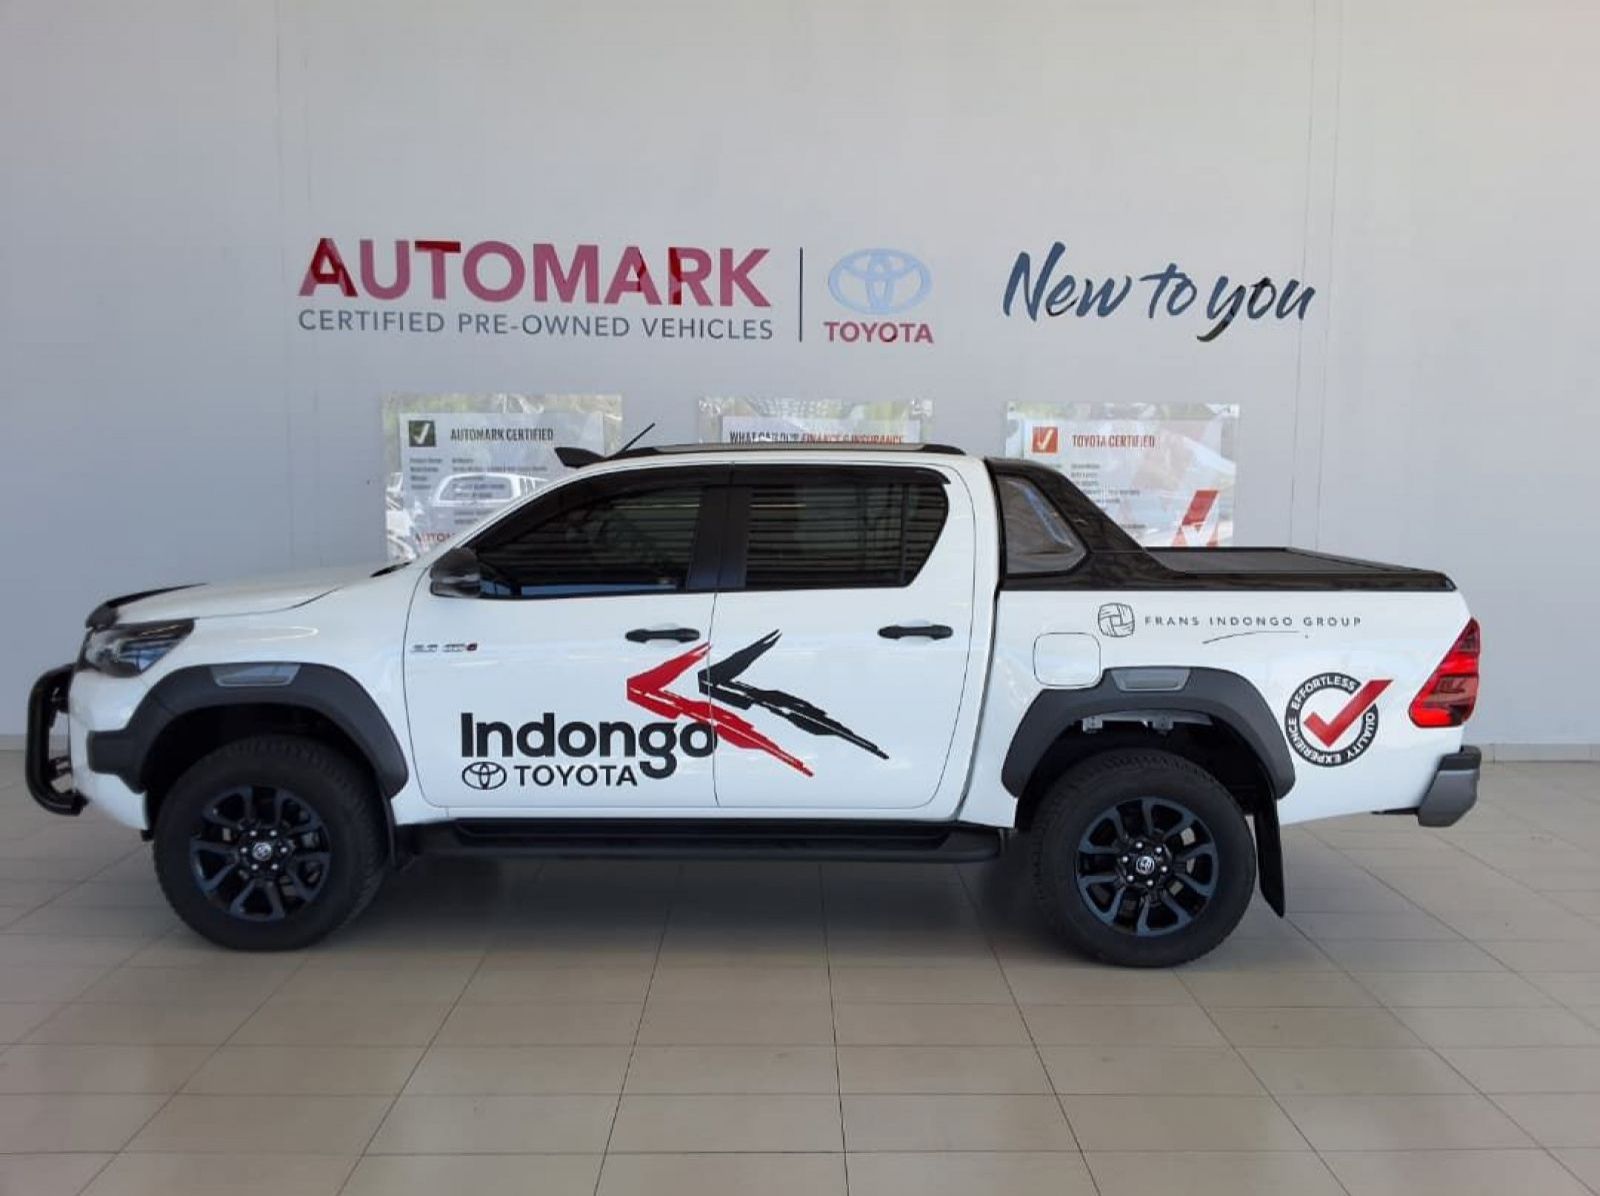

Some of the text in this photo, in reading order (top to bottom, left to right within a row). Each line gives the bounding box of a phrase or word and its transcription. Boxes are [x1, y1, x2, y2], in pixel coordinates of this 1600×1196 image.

[298, 237, 772, 307] AUTOMARK
[1003, 241, 1316, 343] New to you
[299, 309, 774, 341] CERTIFIED PRE-OWNED VEHICLES
[823, 321, 934, 345] TOYOTA
[450, 427, 554, 442] AUTOMARK CERTIFIED
[728, 430, 756, 443] WHAT
[1072, 435, 1156, 448] TOYOTA CERTIFIED
[1144, 616, 1362, 627] FRANS INDONGO GROUP
[1288, 675, 1376, 765] EFFORTLESS QUALITY EXPERIENCE
[460, 712, 718, 779] Indongo
[513, 765, 638, 787] TOYOTA
